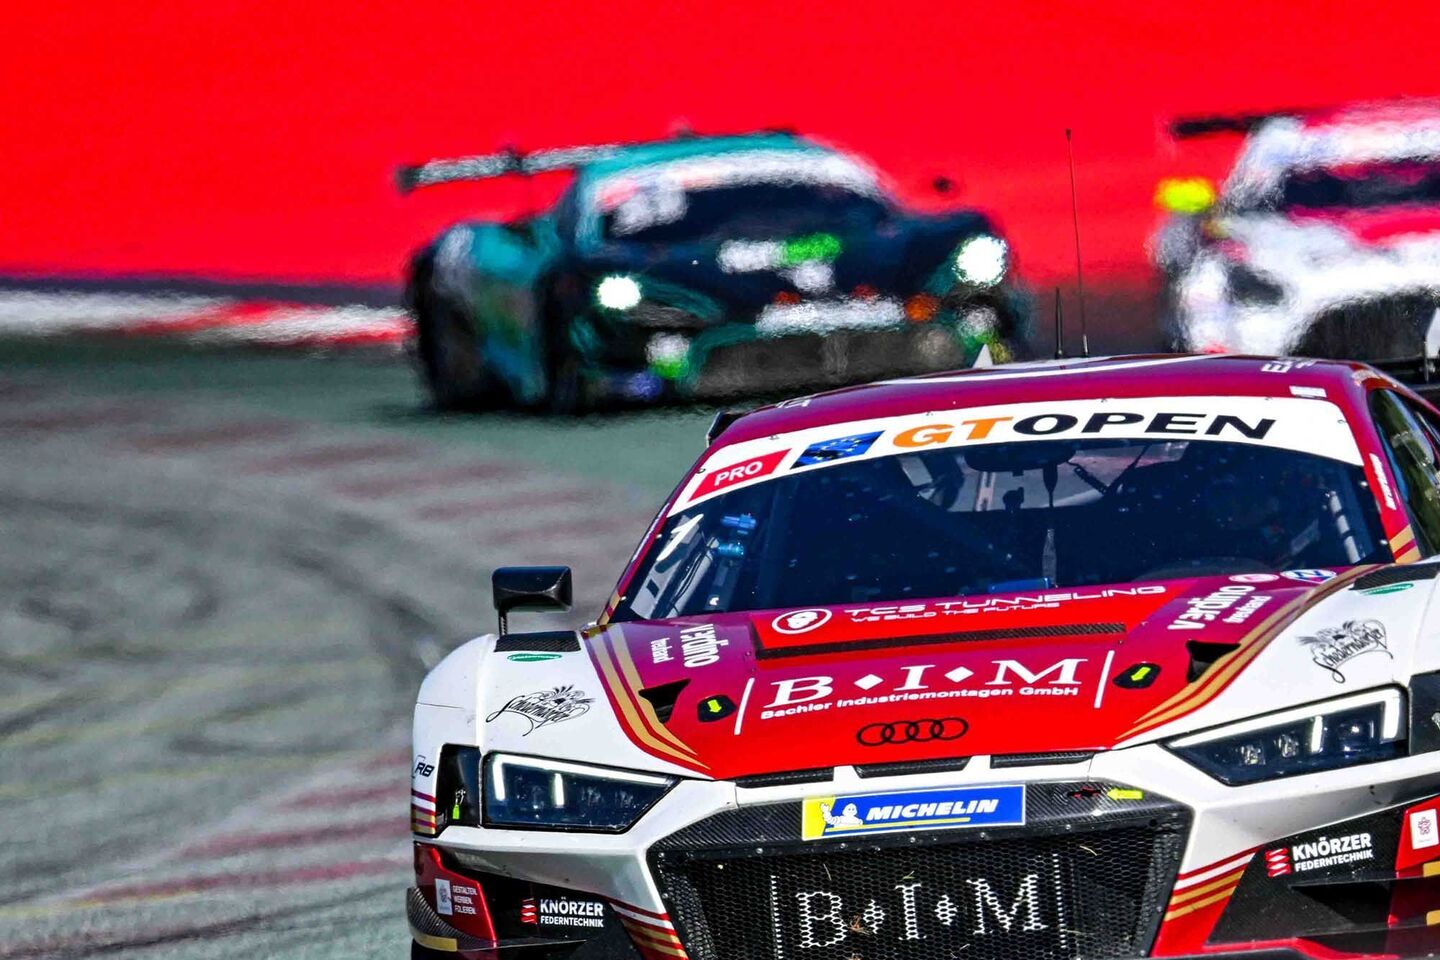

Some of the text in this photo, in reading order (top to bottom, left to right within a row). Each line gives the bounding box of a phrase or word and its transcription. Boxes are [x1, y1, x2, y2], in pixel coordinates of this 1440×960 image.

[713, 461, 763, 486] PRO
[844, 586, 1167, 616] TCS TUNNELING
[851, 602, 1060, 623] WE BUILD THE FUTURE
[837, 685, 1013, 707] Industriemontagen
[1019, 686, 1078, 696] GmbH
[415, 762, 435, 778] R8
[866, 799, 999, 821] MICHELIN
[1292, 833, 1372, 861] KNÖRZER
[1294, 849, 1374, 872] FEDERNTECHNIK
[540, 896, 604, 917] KNÖRZER
[540, 915, 604, 928] FEDERNTECHNIK
